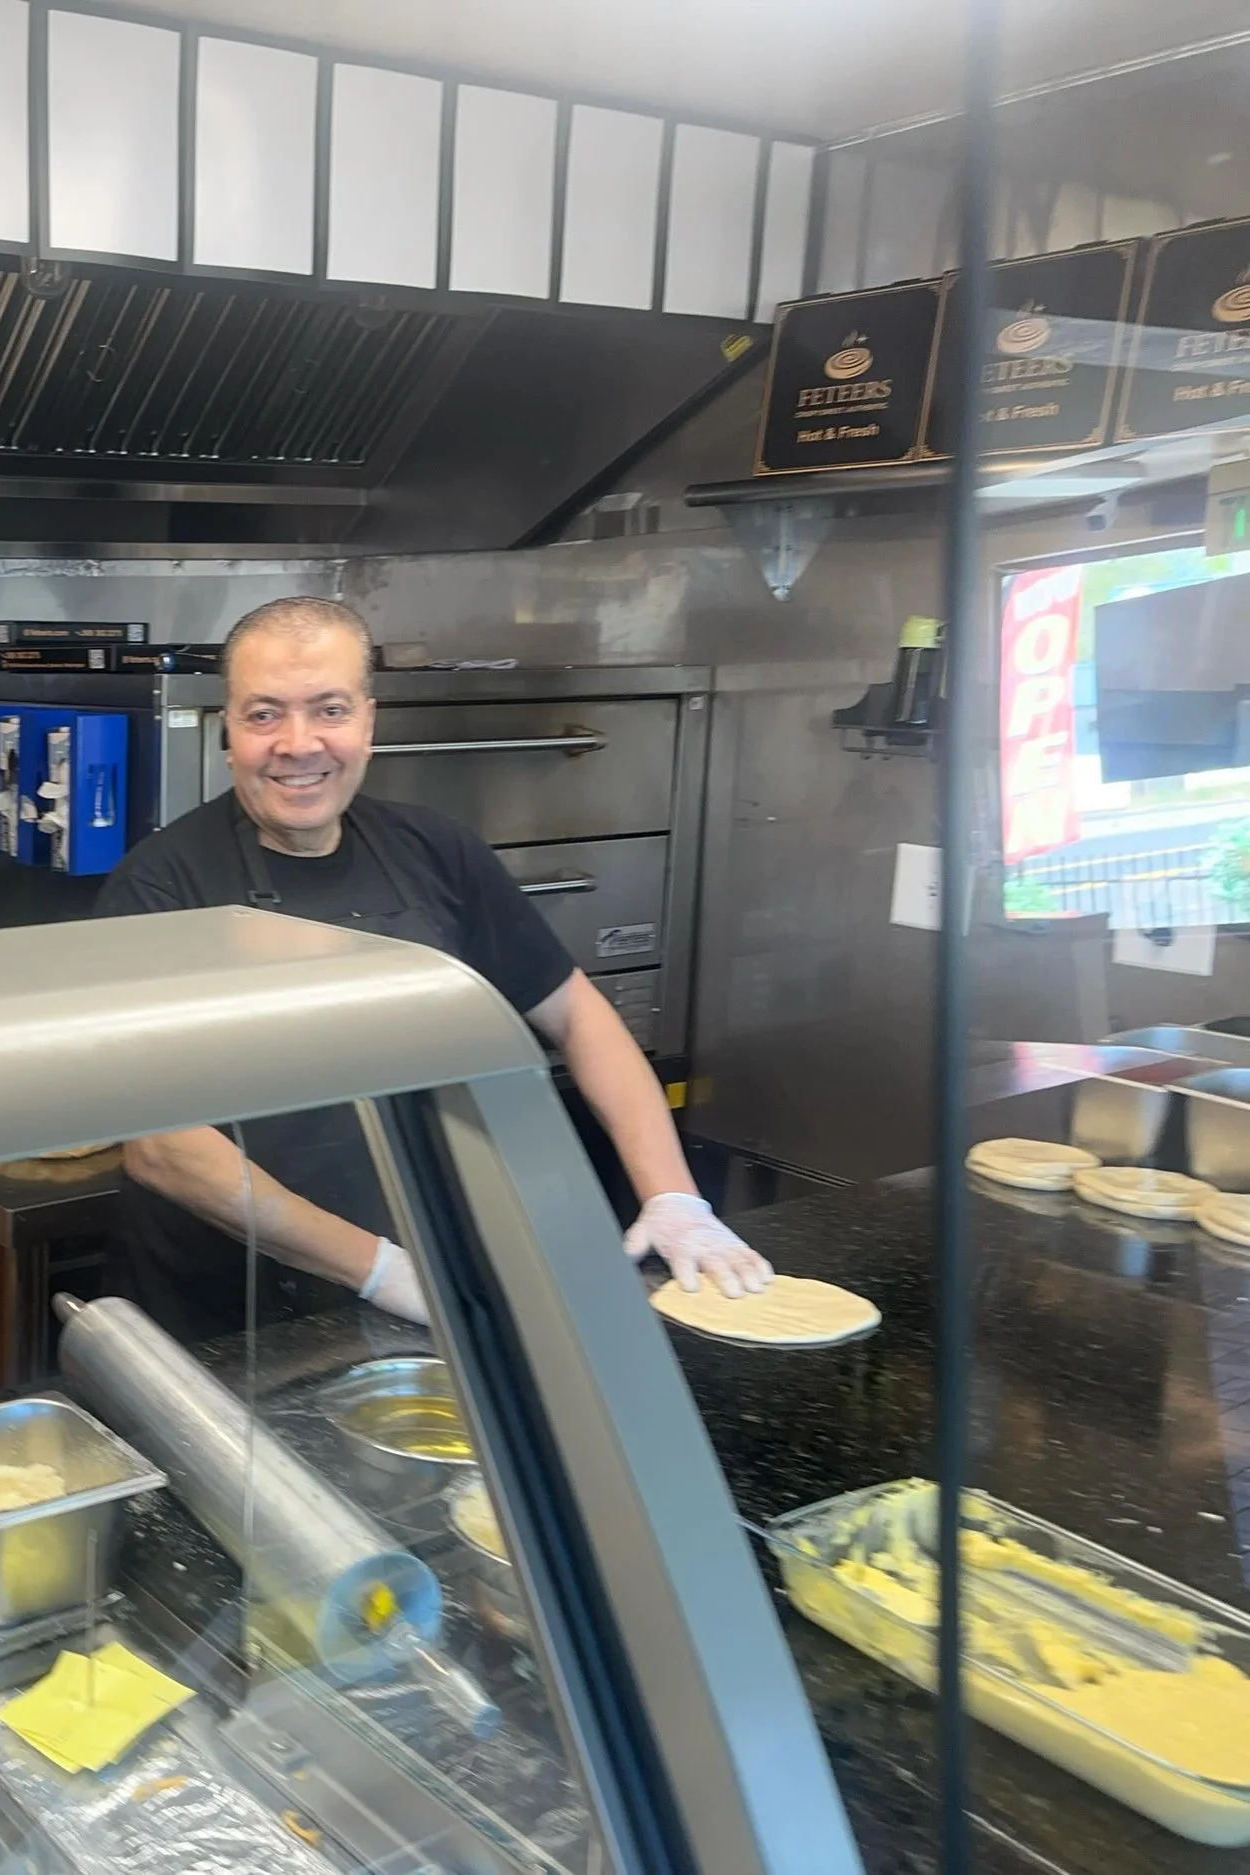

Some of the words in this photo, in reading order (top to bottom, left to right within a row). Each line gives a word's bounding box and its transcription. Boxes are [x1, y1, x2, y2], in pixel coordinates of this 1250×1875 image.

[980, 352, 1074, 383] ETEERS
[797, 379, 893, 408] FETEERS
[1011, 400, 1060, 419] Fresh
[796, 428, 824, 443] Hot
[823, 426, 837, 441] &
[836, 423, 880, 440] Fresh
[1006, 612, 1071, 855] OPEN
